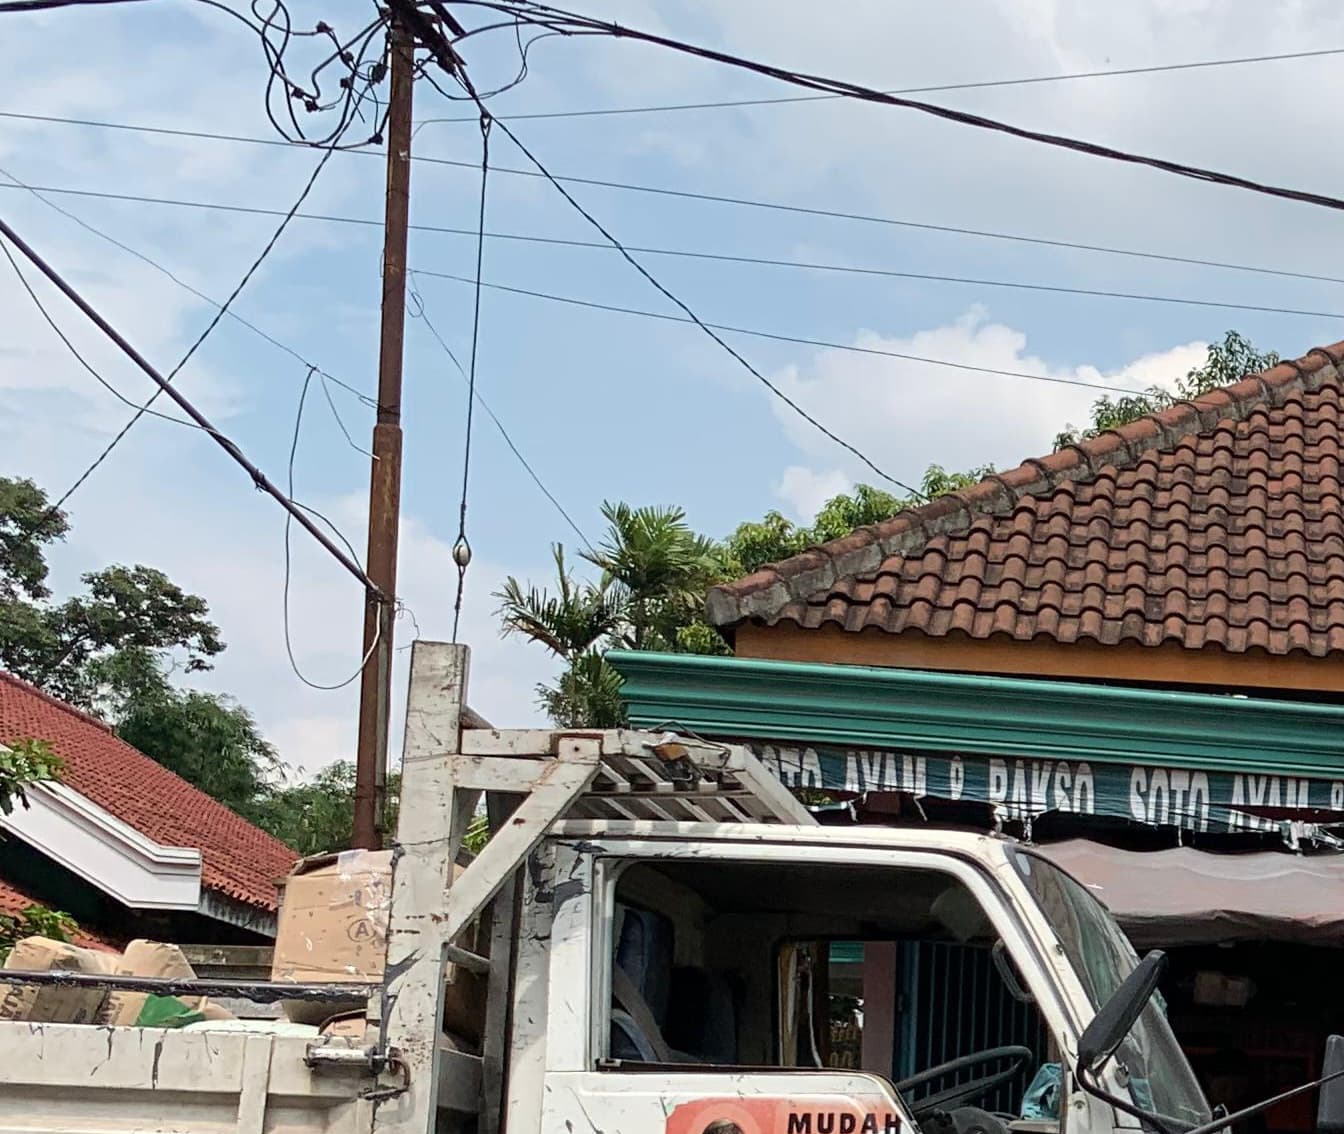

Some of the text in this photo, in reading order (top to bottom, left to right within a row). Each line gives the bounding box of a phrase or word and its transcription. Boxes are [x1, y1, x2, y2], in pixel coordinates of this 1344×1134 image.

[761, 746, 823, 789] OTO
[989, 758, 1095, 818] BAKSO
[1129, 767, 1210, 832] SOTO
